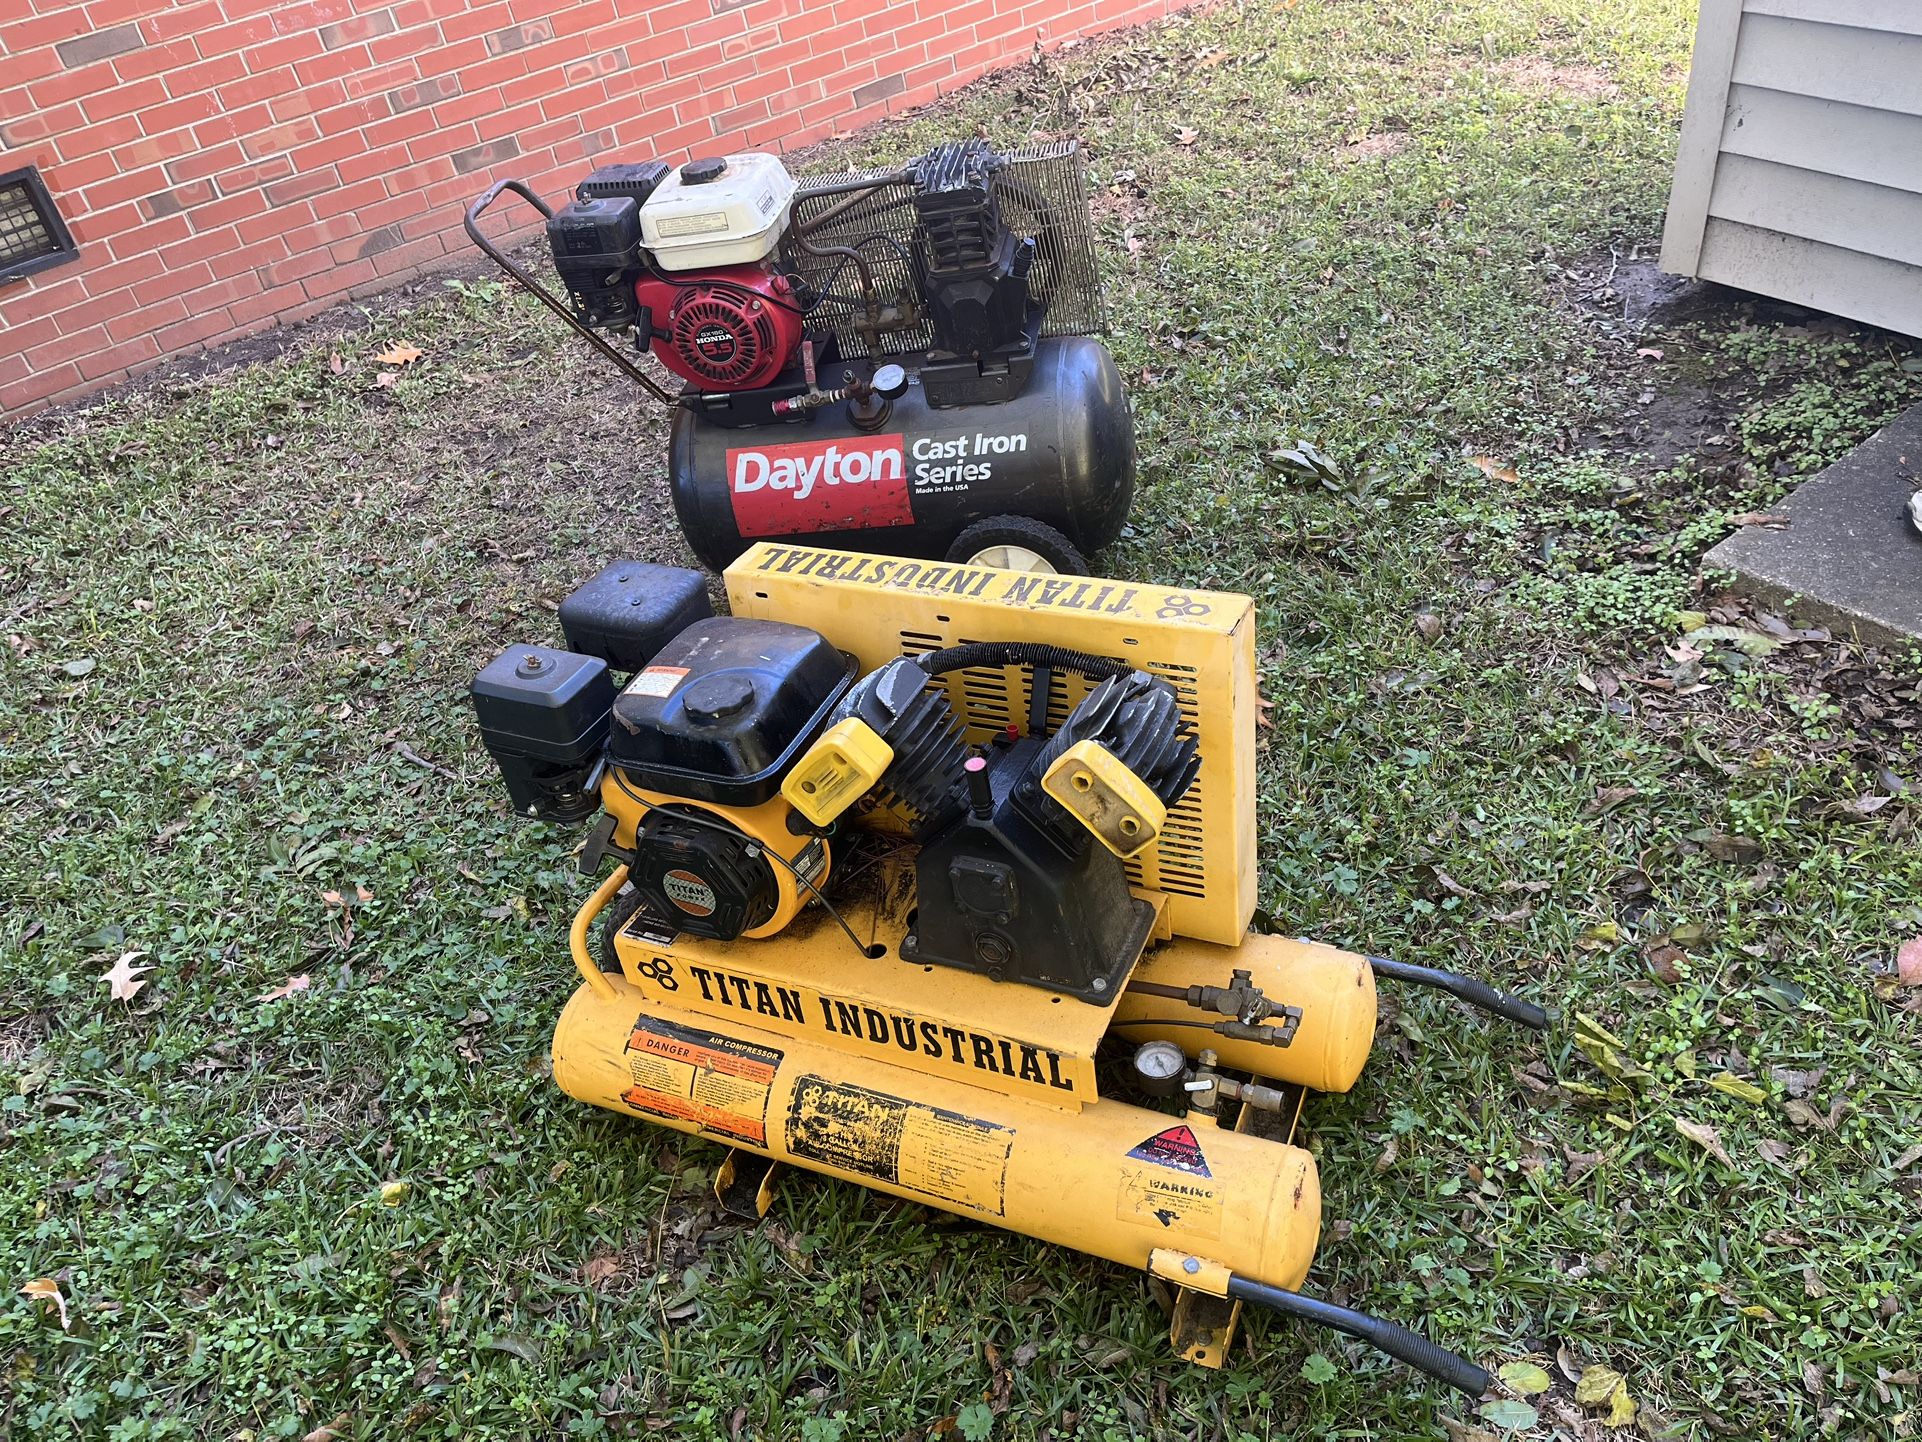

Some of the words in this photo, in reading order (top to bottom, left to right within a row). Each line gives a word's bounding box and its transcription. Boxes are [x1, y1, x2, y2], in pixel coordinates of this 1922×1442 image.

[696, 334, 733, 344] HONDA
[703, 343, 732, 355] 5.5
[912, 435, 969, 461] Cast
[974, 433, 1027, 456] Iron
[734, 445, 901, 500] Dayton
[914, 459, 992, 486] Series
[954, 483, 969, 491] USA
[760, 547, 996, 598] INDUSTRIAL
[1002, 575, 1138, 614] TITAN
[668, 883, 705, 896] TITAN
[689, 966, 805, 1025] TITAN
[819, 997, 1075, 1093] INDUSTRIAL
[646, 1039, 690, 1058] DANGER
[708, 1036, 723, 1047] AIR
[724, 1040, 779, 1061] COMPRESSOR
[824, 1091, 890, 1121] TITAN
[1154, 1139, 1197, 1156] WARNING
[1149, 1179, 1213, 1199] WARNING
